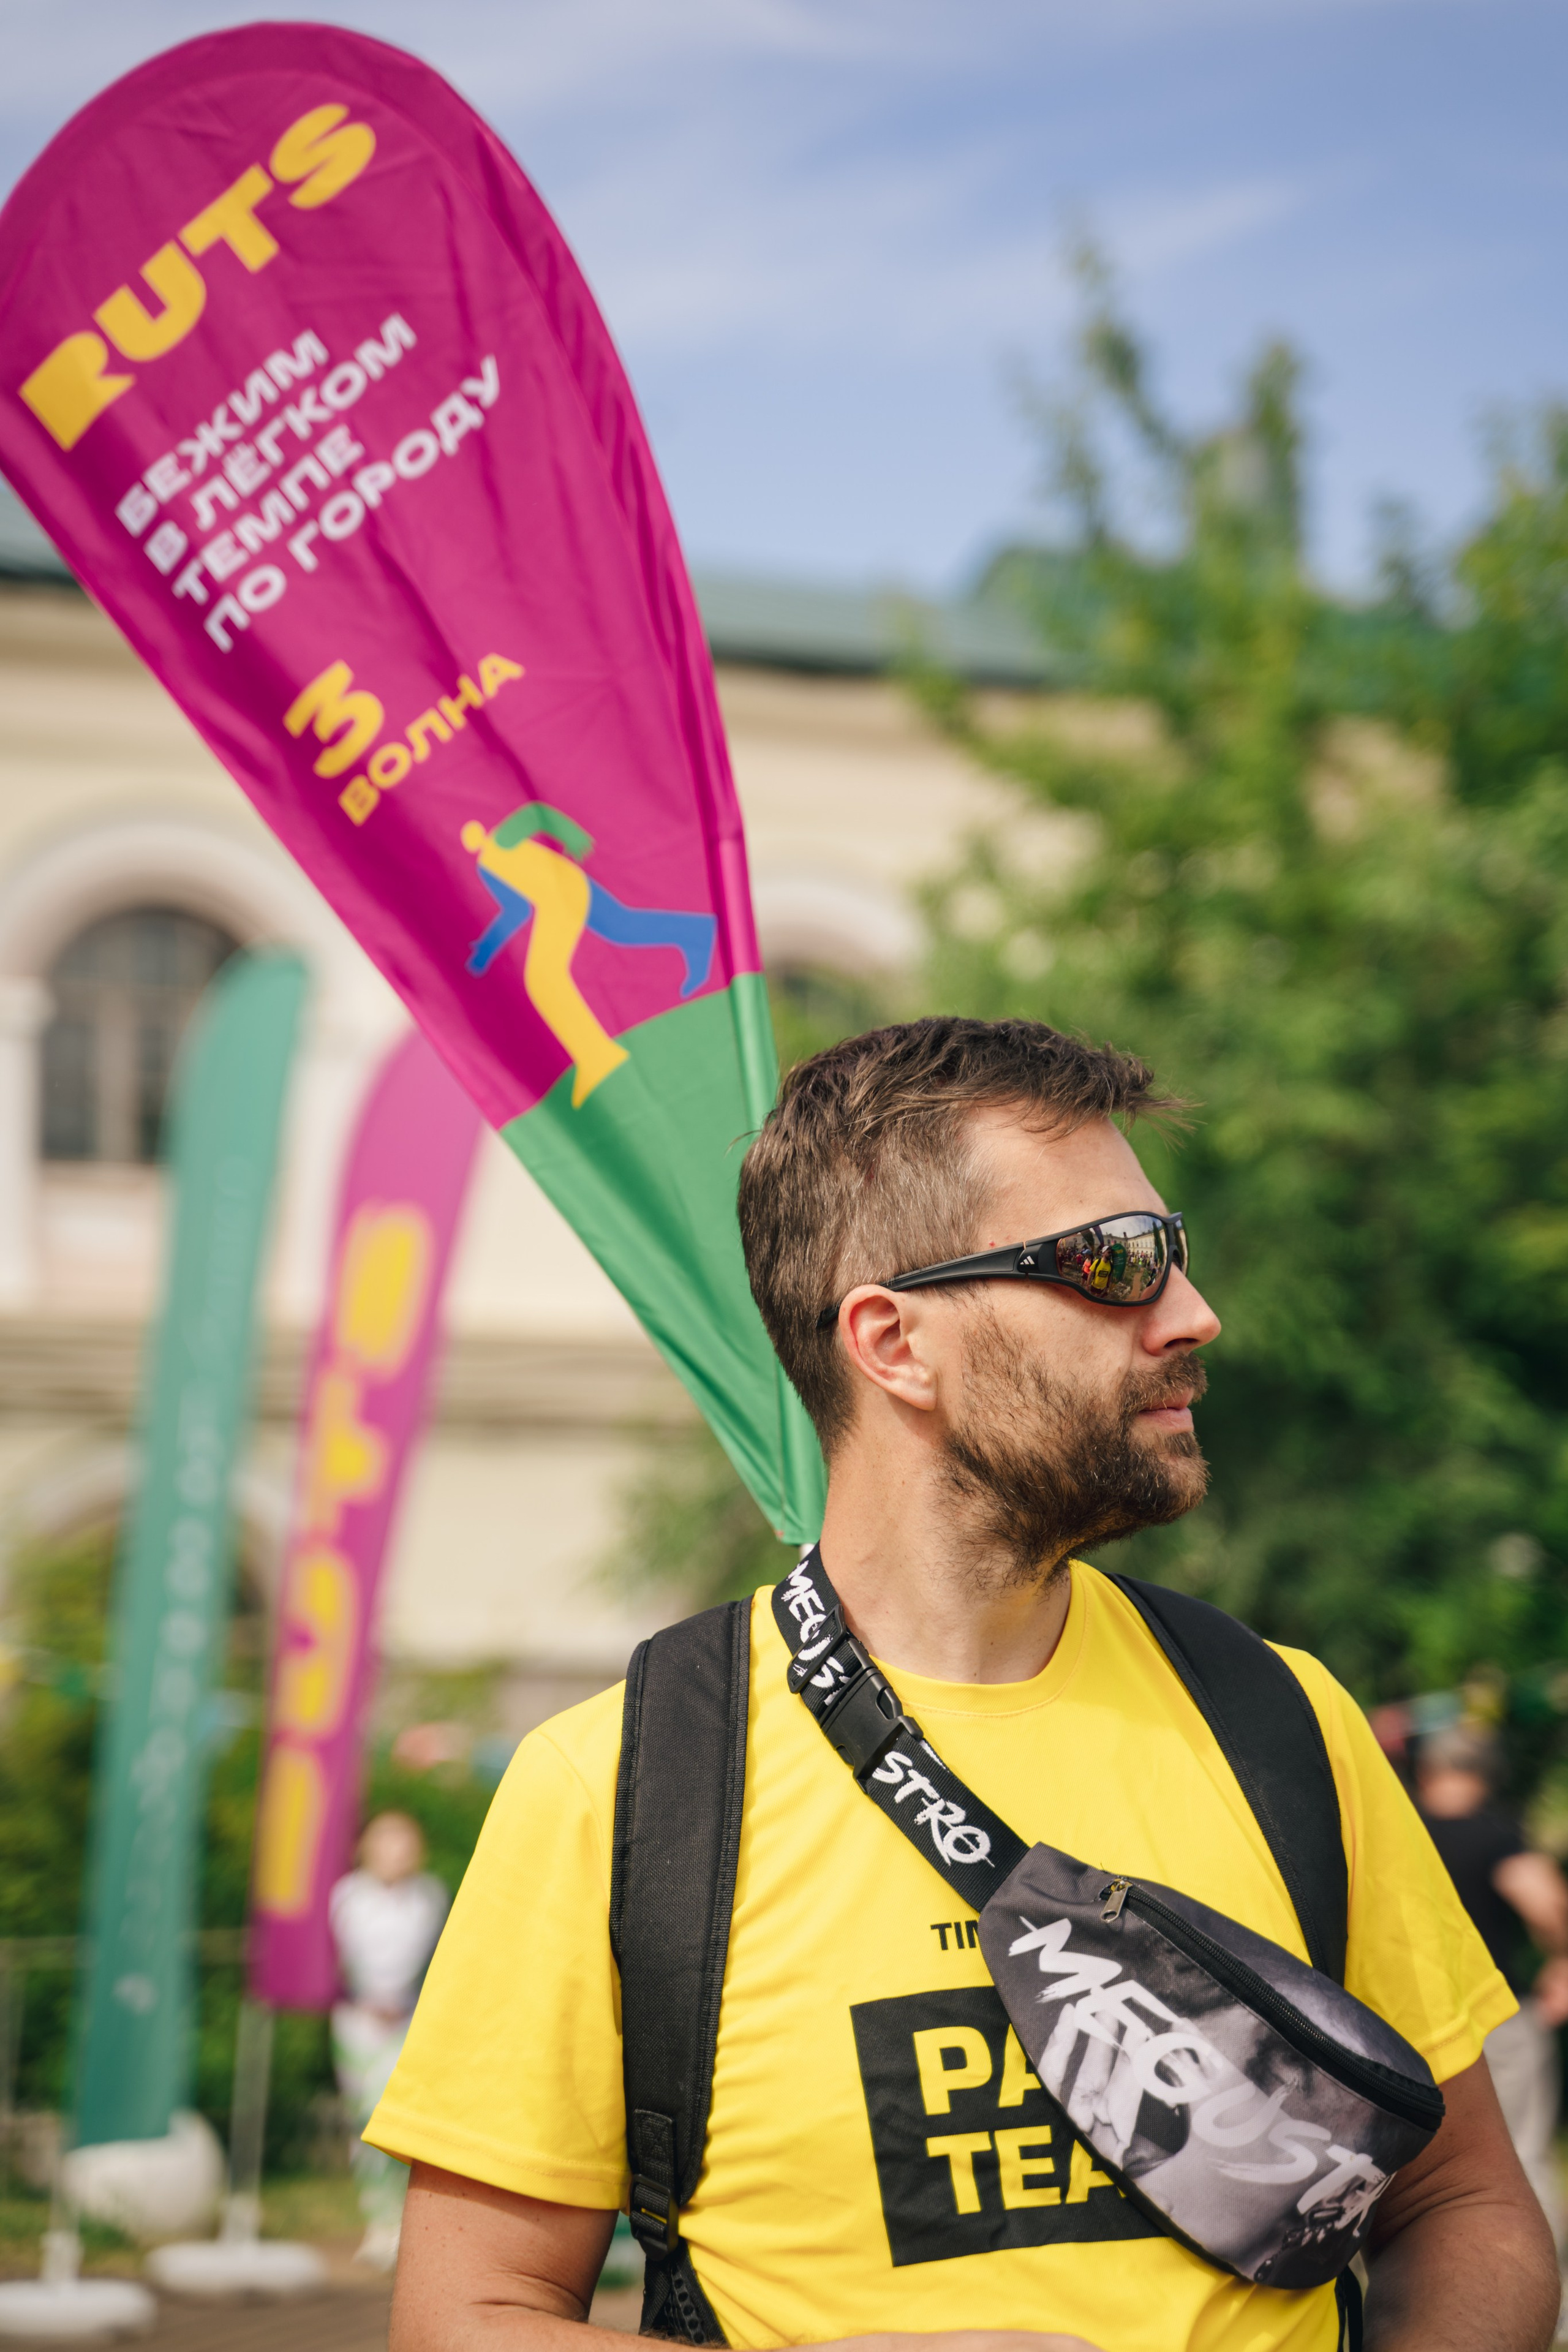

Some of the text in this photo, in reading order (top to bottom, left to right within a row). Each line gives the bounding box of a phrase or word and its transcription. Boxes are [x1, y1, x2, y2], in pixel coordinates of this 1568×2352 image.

[18, 102, 377, 452] RUTS
[115, 328, 331, 538] БЕЖИМ
[144, 312, 418, 576] В ЛЁГКОМ
[172, 423, 365, 605] ТЕМПЕ
[203, 354, 501, 653] ПО ГОРОДУ
[283, 659, 385, 779] 3
[338, 652, 526, 827] ВОЛНА
[872, 1751, 995, 1867] STRO
[913, 2023, 1041, 2116] PA
[927, 2125, 1128, 2215] TEA
